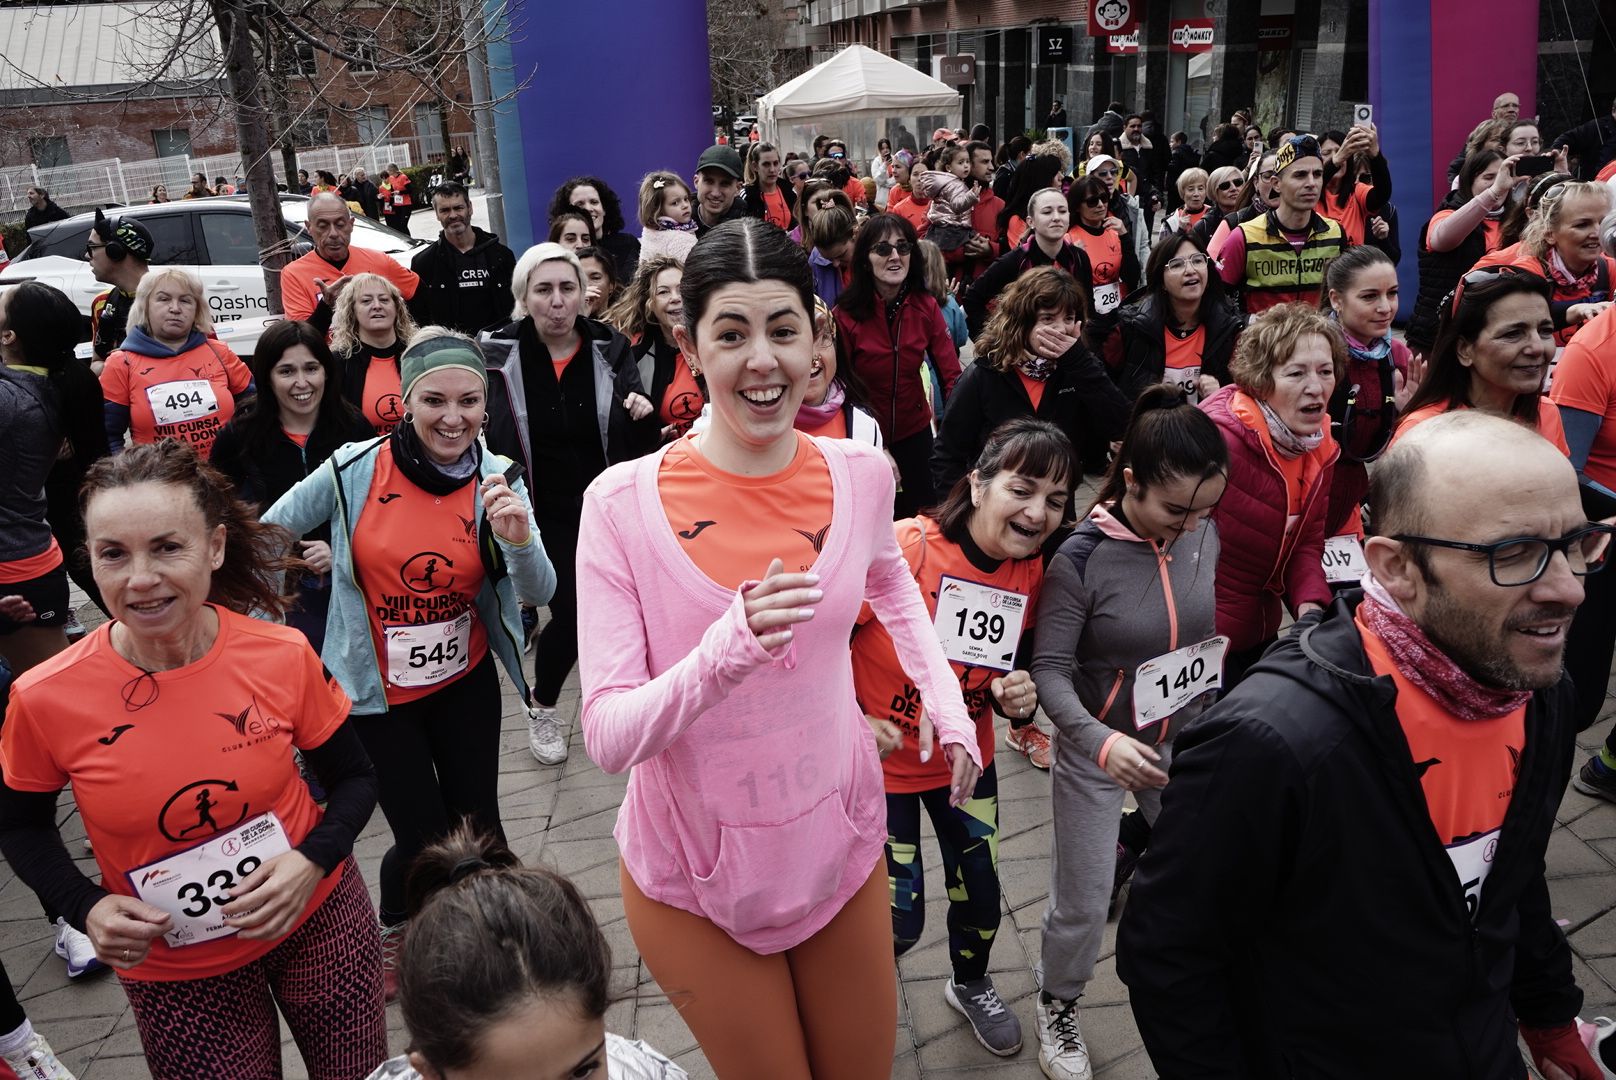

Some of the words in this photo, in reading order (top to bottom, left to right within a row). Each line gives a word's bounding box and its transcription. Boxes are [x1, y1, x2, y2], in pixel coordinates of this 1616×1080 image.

[1174, 31, 1183, 40] KID
[1190, 31, 1212, 40] MONKEY
[208, 294, 269, 312] Qashq
[165, 390, 203, 410] 494
[154, 425, 176, 436] VIII
[178, 417, 220, 434] CURSA
[190, 427, 222, 443] DON
[381, 593, 410, 610] VIII
[376, 606, 399, 622] DE
[403, 610, 425, 624] LA
[955, 608, 1005, 644] 139
[408, 636, 459, 668] 545
[1156, 657, 1204, 698] 140
[903, 683, 922, 704] VI
[890, 694, 919, 720] DE
[221, 743, 243, 753] CLUB
[1497, 789, 1513, 800] CLU
[250, 819, 269, 832] CURSA
